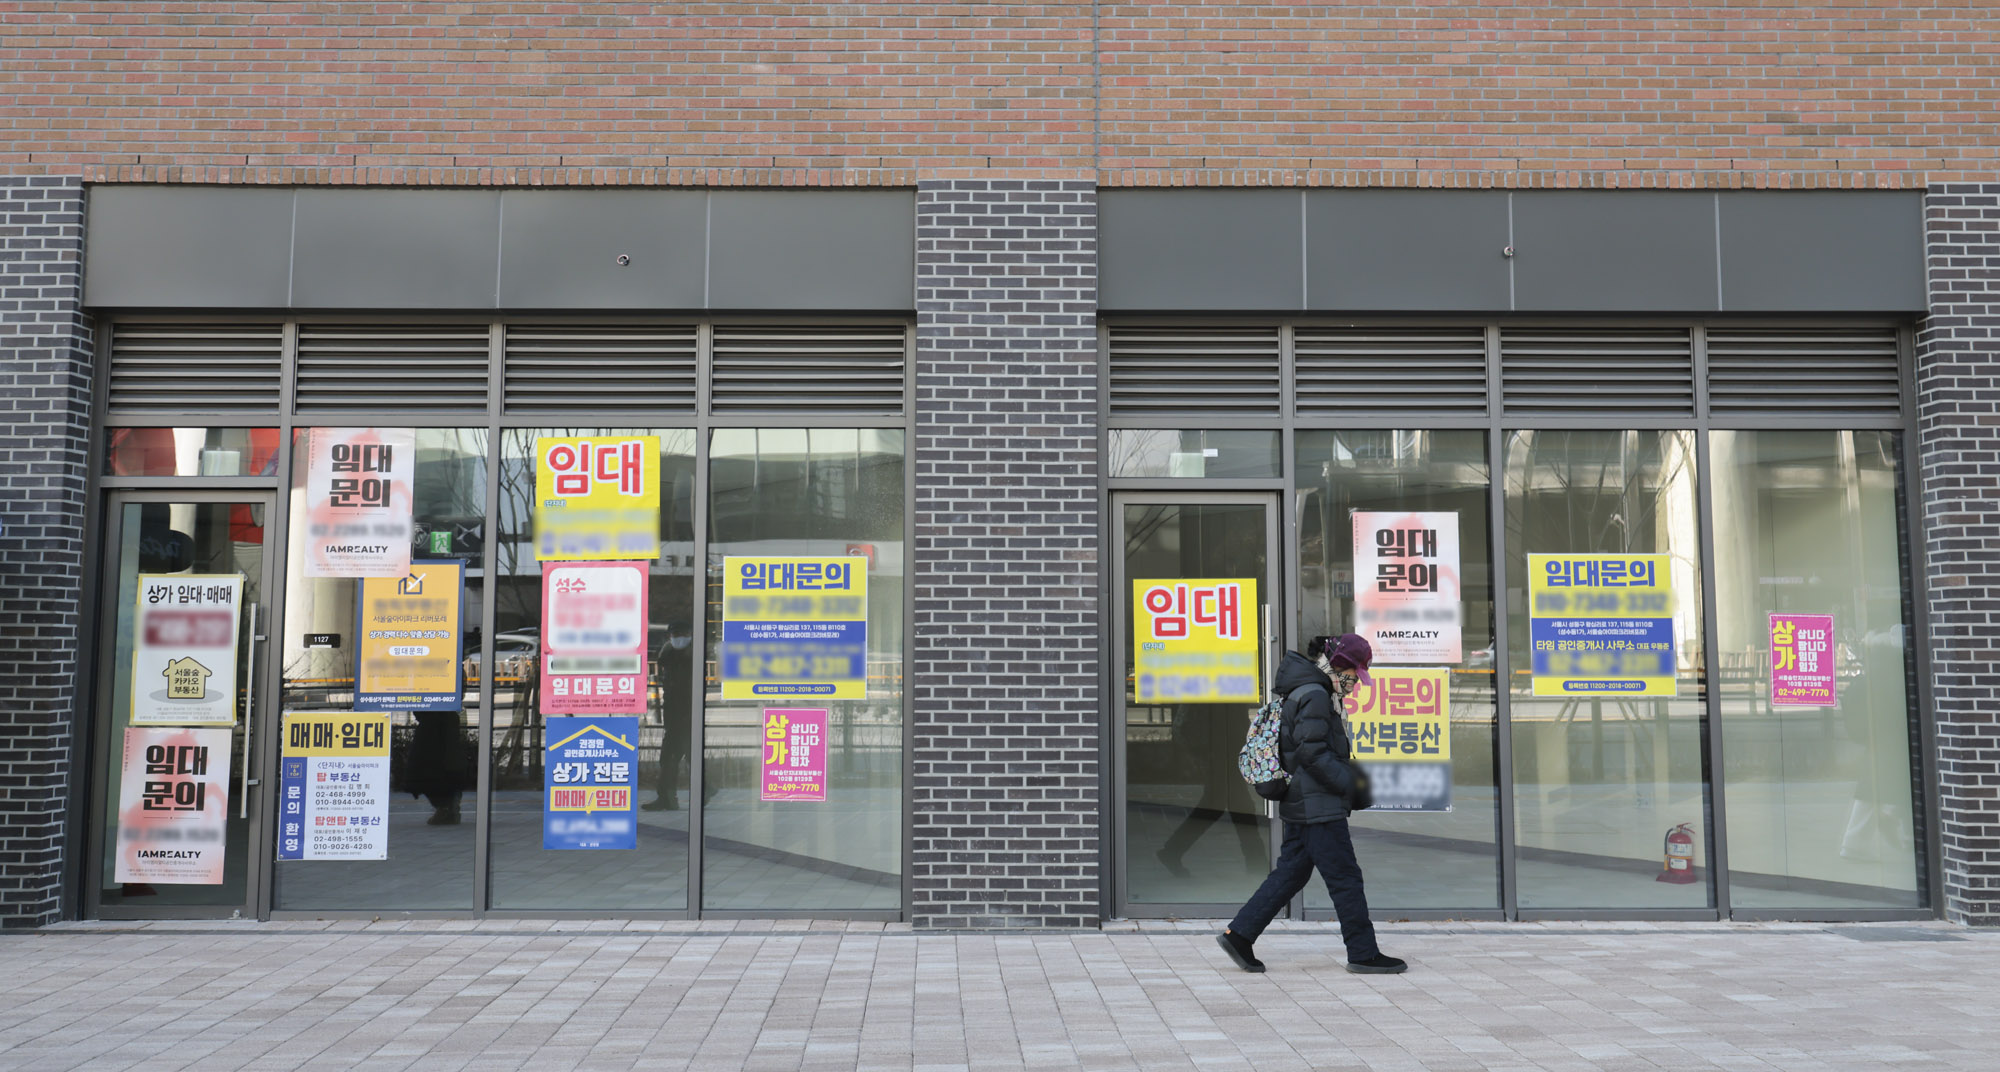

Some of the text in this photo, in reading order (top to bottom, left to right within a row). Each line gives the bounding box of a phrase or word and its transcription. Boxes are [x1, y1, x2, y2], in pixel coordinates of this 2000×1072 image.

[331, 444, 393, 473] 임대
[547, 442, 642, 495] 임대
[329, 478, 391, 508] 문의
[1376, 529, 1437, 557] 임대
[326, 545, 389, 553] IAMREALTY
[740, 563, 850, 590] 임대문의
[1376, 563, 1438, 592] 문의
[1545, 560, 1655, 587] 임대문의
[147, 585, 232, 604] 상가 임대·매매
[1144, 585, 1239, 638] 임대
[373, 615, 447, 623] 서울숲아이파크 리버포레
[800, 624, 812, 632] 137,
[1607, 621, 1619, 629] 137,
[1377, 630, 1439, 638] IAMREALTY
[1798, 629, 1826, 640] 삽니다
[1536, 640, 1555, 650] 타임
[1557, 640, 1604, 650] 공인중개사
[1606, 640, 1635, 650] 사무소
[1772, 621, 1797, 670] 상가
[1798, 641, 1827, 652] 팝니다
[394, 647, 423, 655] 임대문의
[174, 668, 200, 677] 서울숲
[1799, 661, 1818, 673] 임차
[174, 677, 199, 686] 카카오
[552, 677, 635, 695] 임대문의
[174, 686, 199, 694] 부동산
[1778, 688, 1829, 697] 02-499-7770
[791, 723, 819, 734] 삽니다
[290, 722, 384, 749] 매매·임대
[765, 714, 790, 765] 상가
[791, 735, 820, 746] 팝니다
[1348, 721, 1441, 754] 산부동산
[579, 739, 604, 749] 권정원
[564, 749, 619, 758] 공인중개사사무소
[145, 745, 208, 775] 임대
[790, 756, 810, 767] 임차
[316, 772, 360, 782] 탑 부동산
[552, 762, 629, 783] 상가 전문
[768, 783, 820, 792] 02-499-7770
[142, 781, 206, 811] 문의
[286, 786, 300, 814] 문의
[554, 789, 627, 808] 매매/임대
[315, 816, 381, 826] 탑앤탑 부동산
[285, 822, 299, 851] 환영
[137, 850, 201, 859] IAMREALTY
